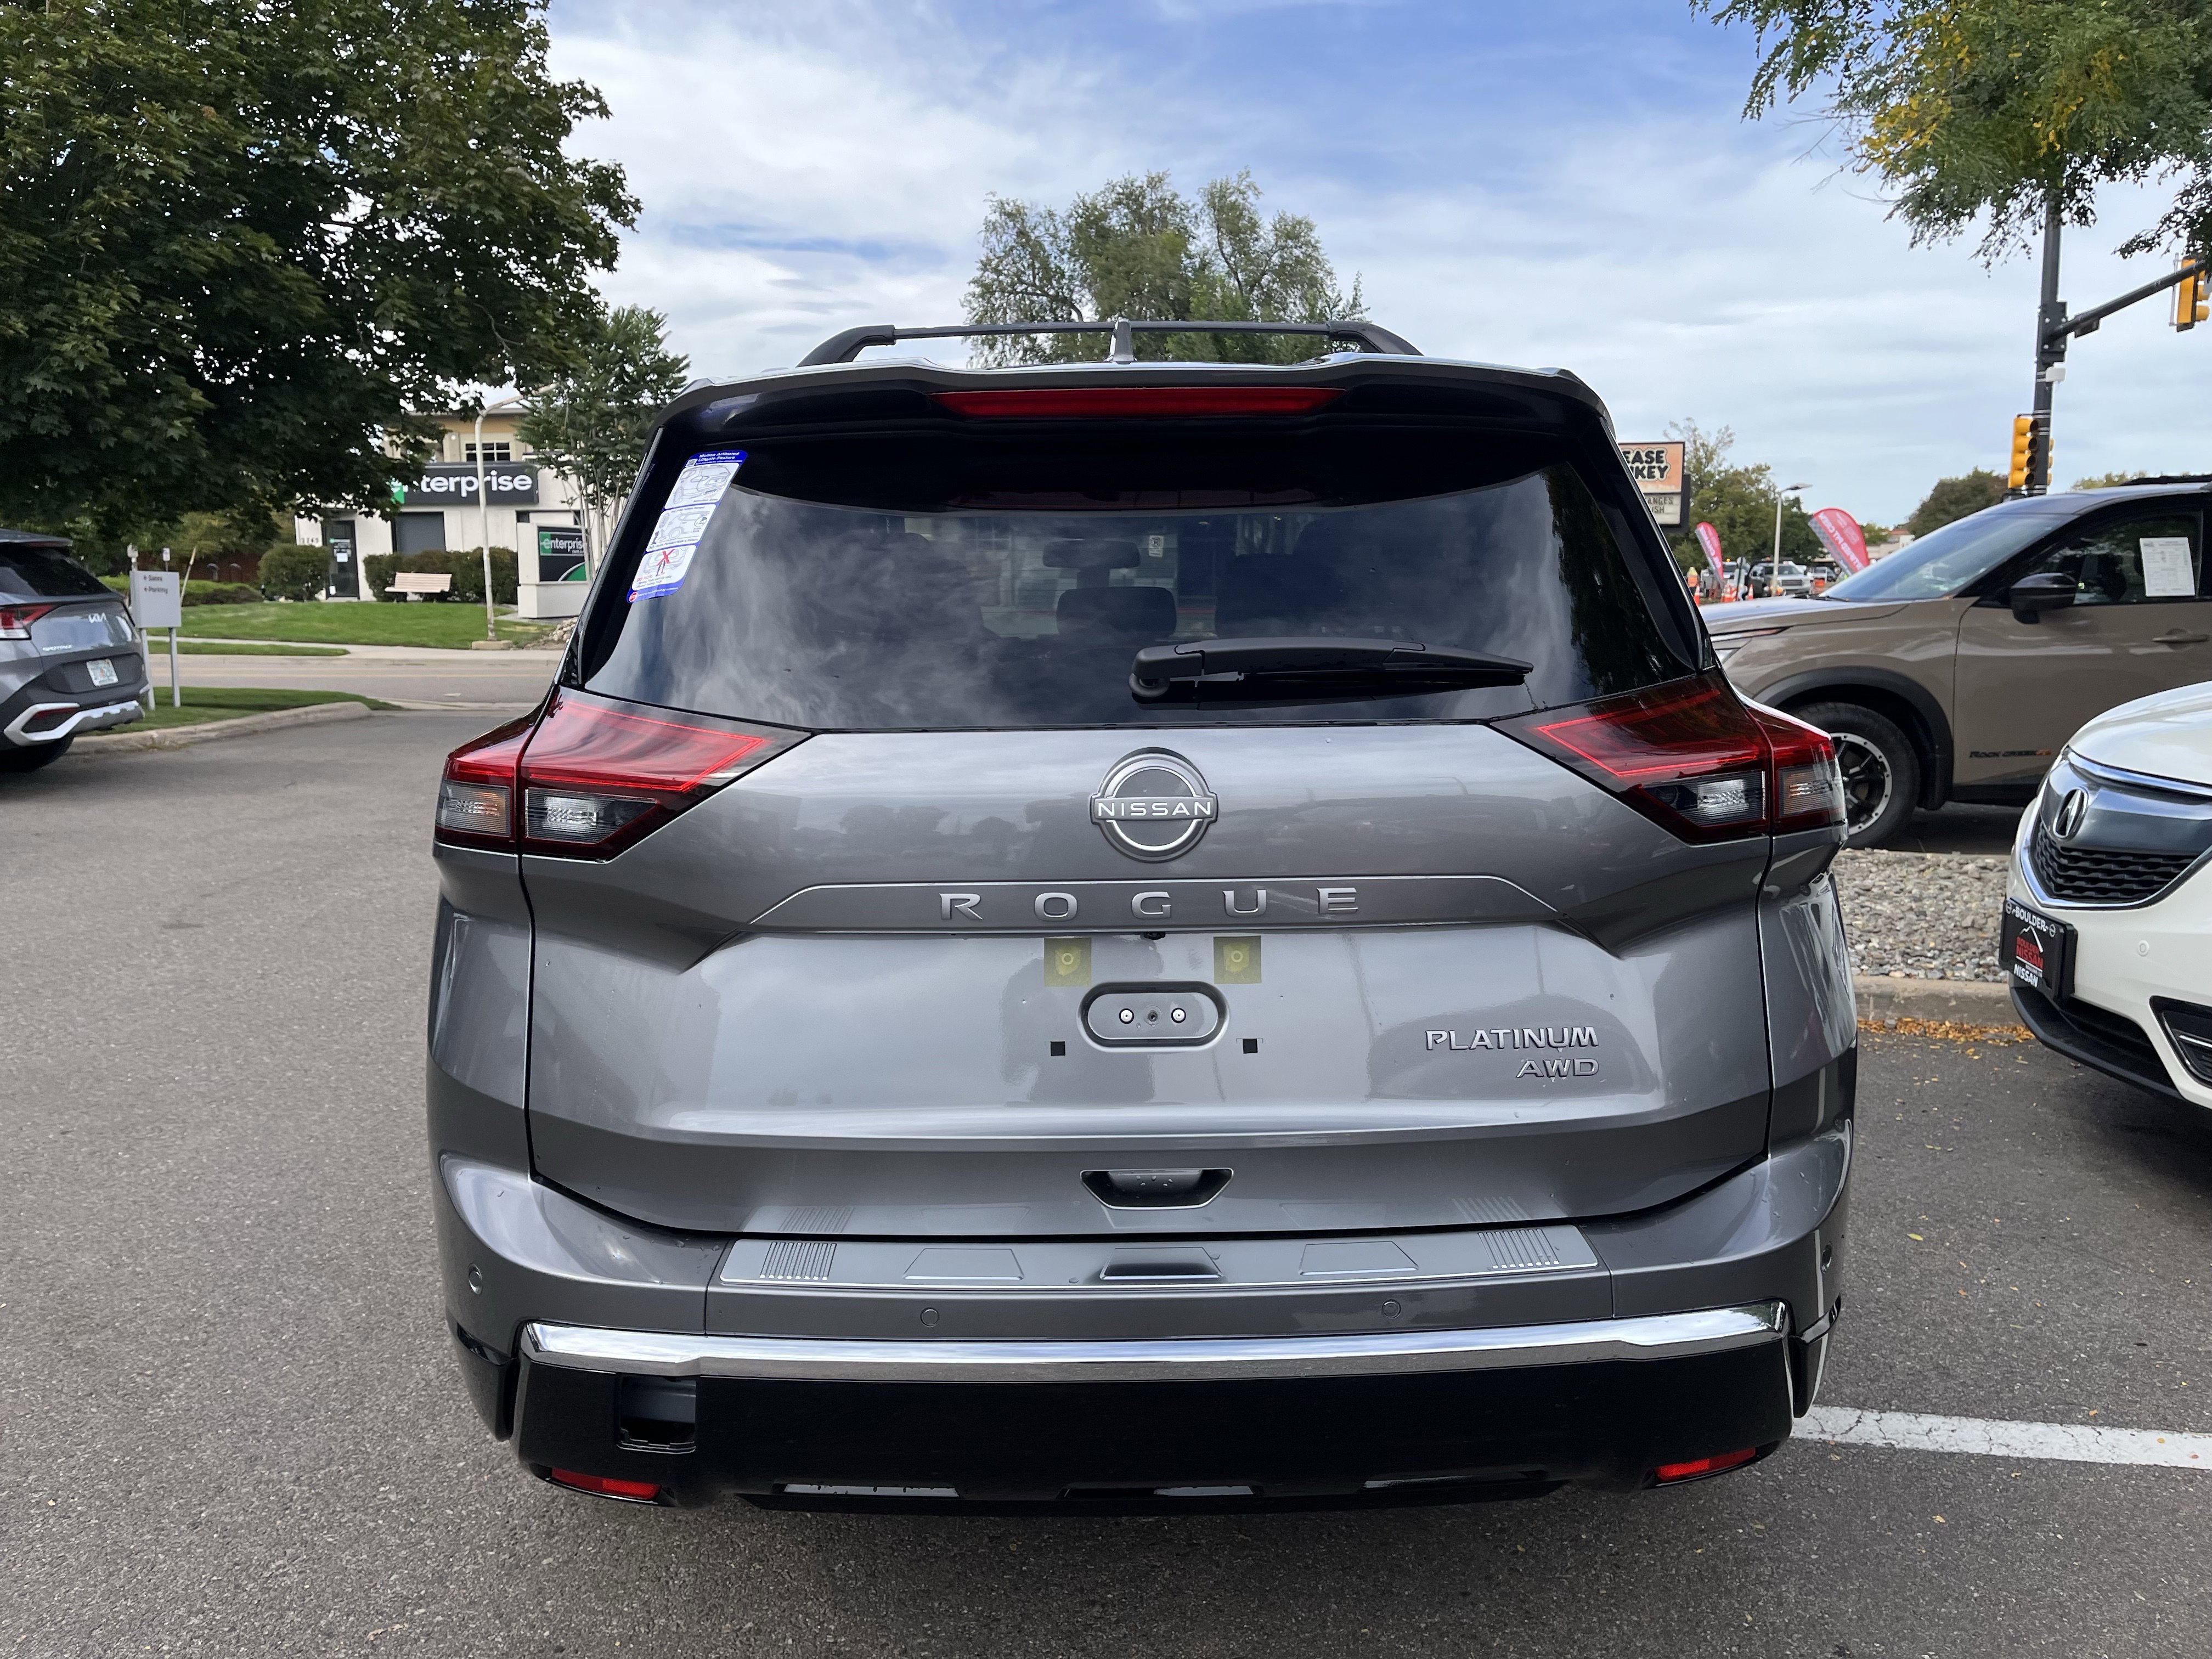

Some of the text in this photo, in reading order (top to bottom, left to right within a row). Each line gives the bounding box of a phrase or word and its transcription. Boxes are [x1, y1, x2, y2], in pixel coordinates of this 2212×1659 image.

[540, 537, 584, 553] enterpris
[1097, 800, 1212, 817] NISSAN
[938, 887, 1359, 921] ROGUE
[2015, 906, 2046, 932] BOULDER
[2016, 945, 2043, 969] NISSAN
[2013, 963, 2039, 988] NISSAN
[1425, 1026, 1599, 1051] PLATINUM
[1515, 1058, 1599, 1079] AWD
